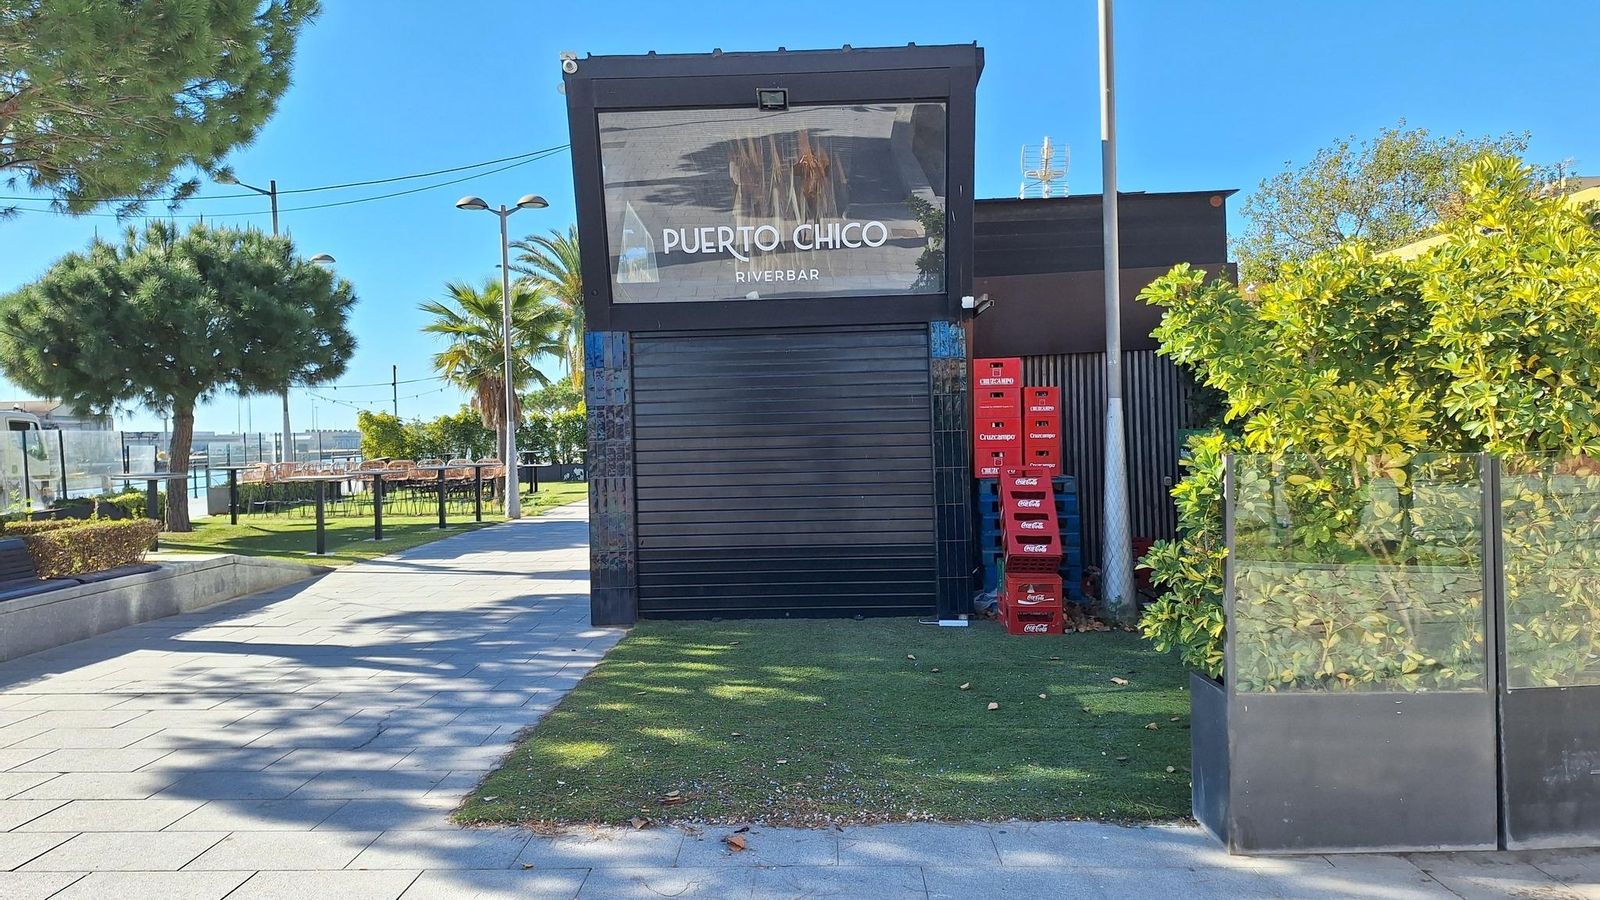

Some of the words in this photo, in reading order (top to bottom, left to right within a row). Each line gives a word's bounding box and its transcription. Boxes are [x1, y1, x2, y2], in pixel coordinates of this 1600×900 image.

[663, 225, 780, 262] PUERTO
[793, 221, 888, 250] CHICO
[736, 269, 819, 283] RIVERBAR
